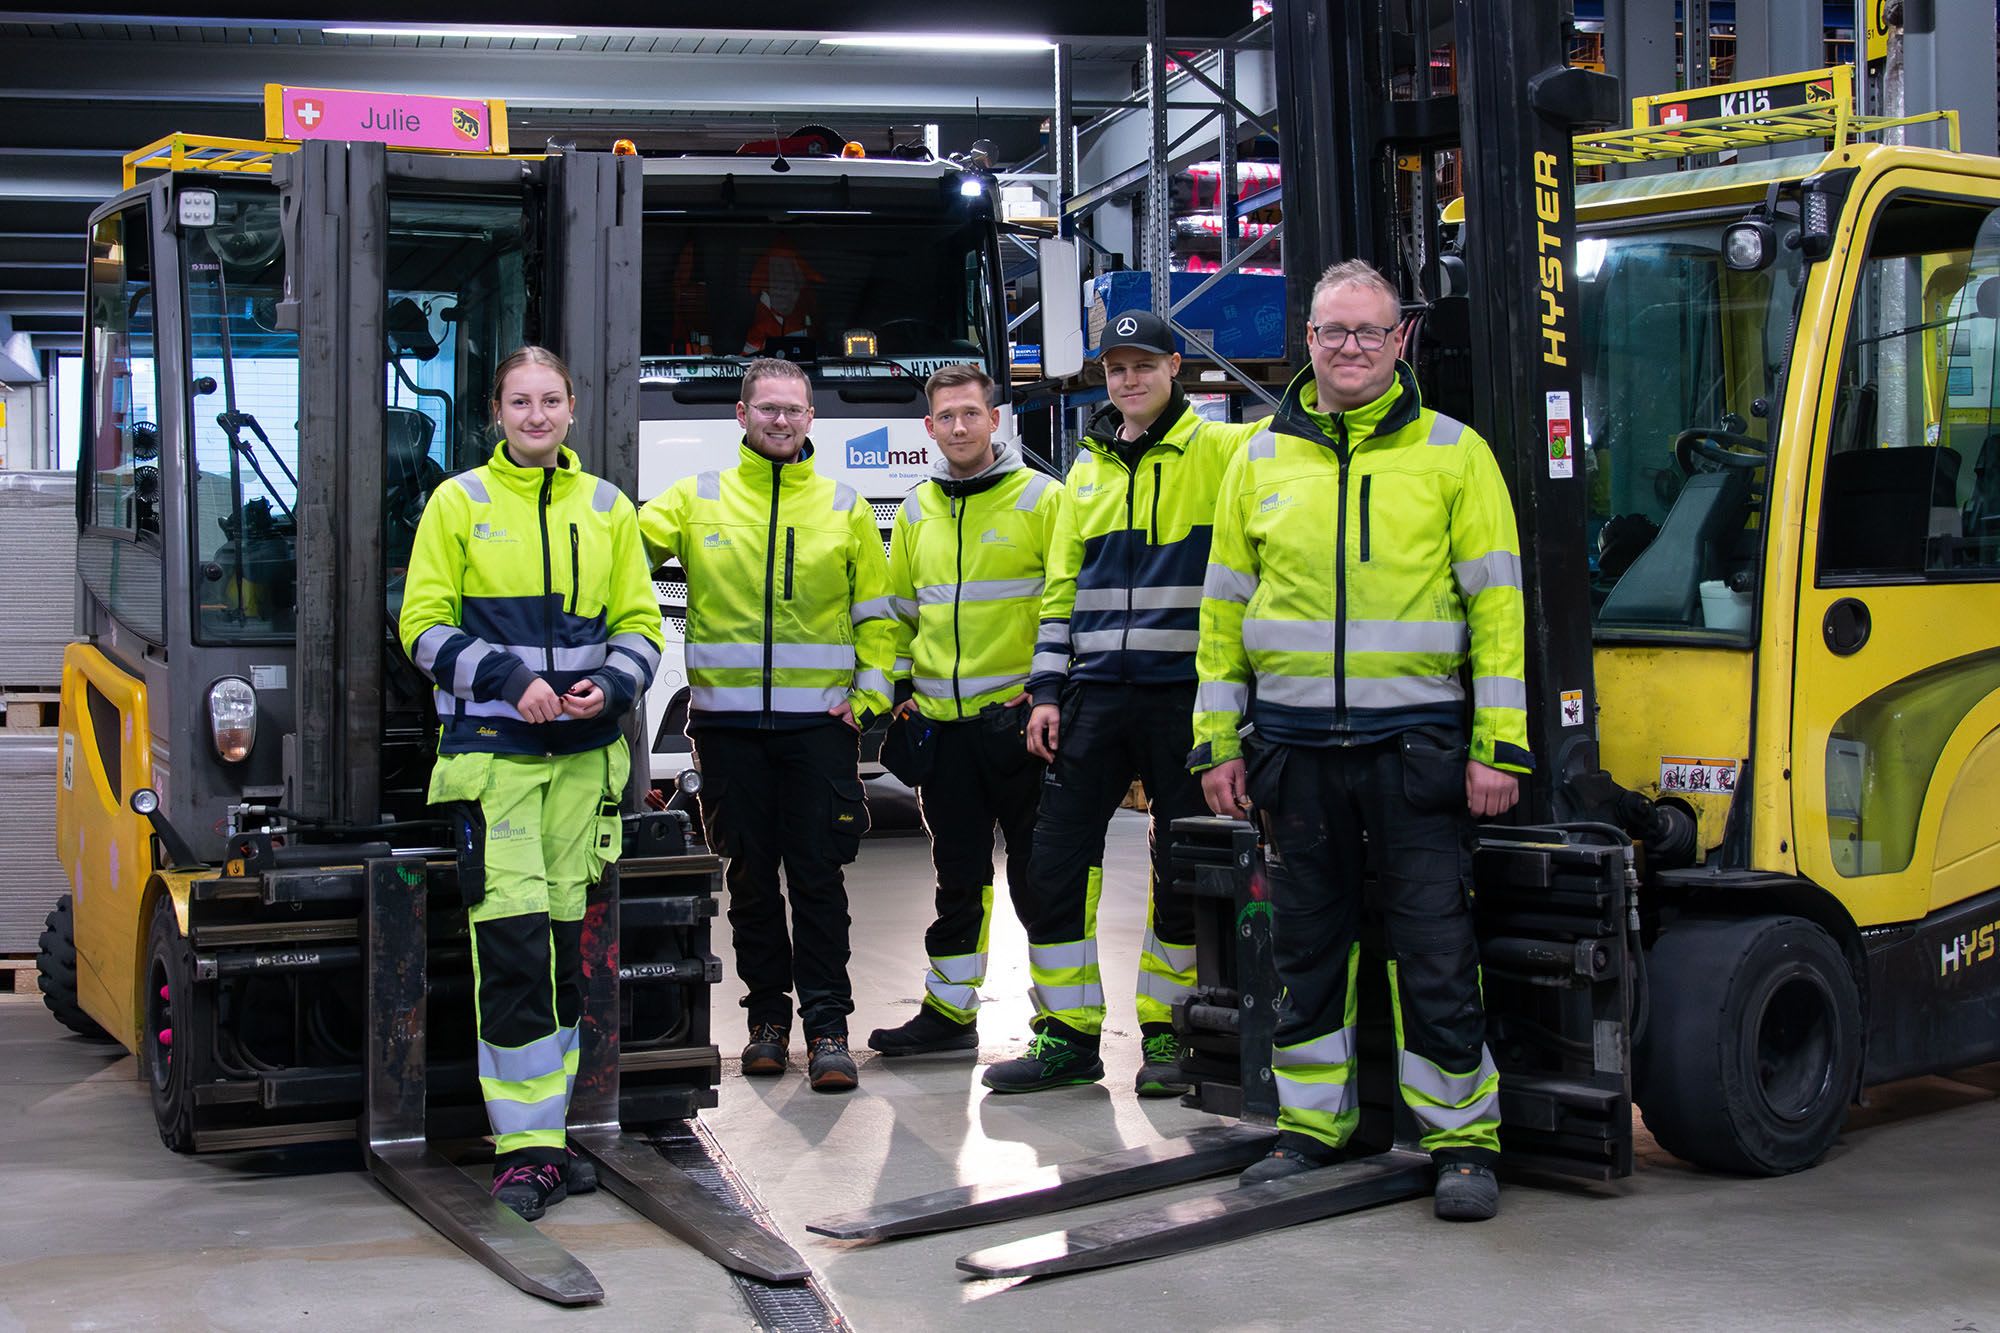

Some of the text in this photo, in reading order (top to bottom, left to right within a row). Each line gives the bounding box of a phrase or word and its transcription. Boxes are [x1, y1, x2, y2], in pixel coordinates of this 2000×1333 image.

[361, 107, 420, 132] Julie
[1534, 151, 1567, 366] HYSTER
[849, 446, 929, 466] baumat
[1940, 920, 2000, 977] HYS
[632, 964, 674, 977] KAUP
